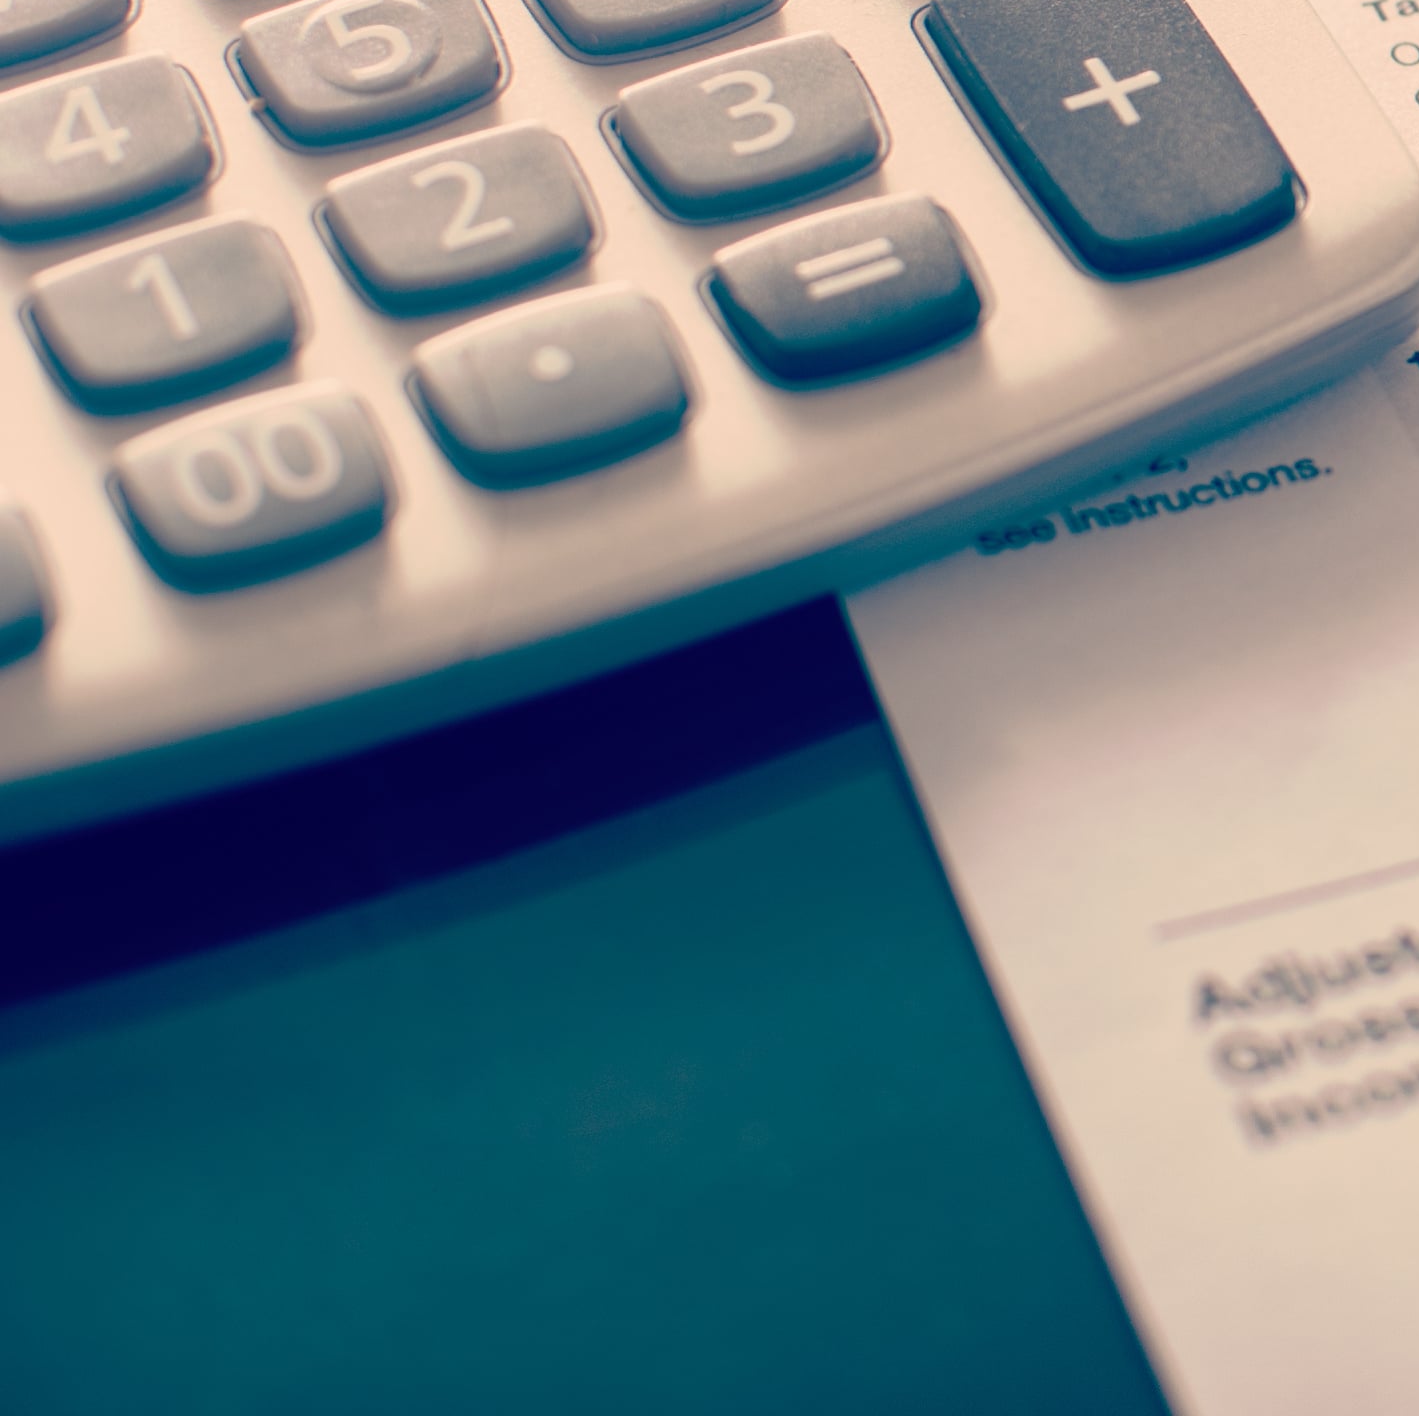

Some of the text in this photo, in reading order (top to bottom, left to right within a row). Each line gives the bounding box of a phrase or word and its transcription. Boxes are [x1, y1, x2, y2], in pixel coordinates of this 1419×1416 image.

[44, 86, 133, 166] 4
[701, 69, 798, 157] 3
[410, 159, 517, 252] 2
[124, 252, 201, 343] 1
[173, 406, 344, 528] 00
[1064, 455, 1335, 536] instructions.
